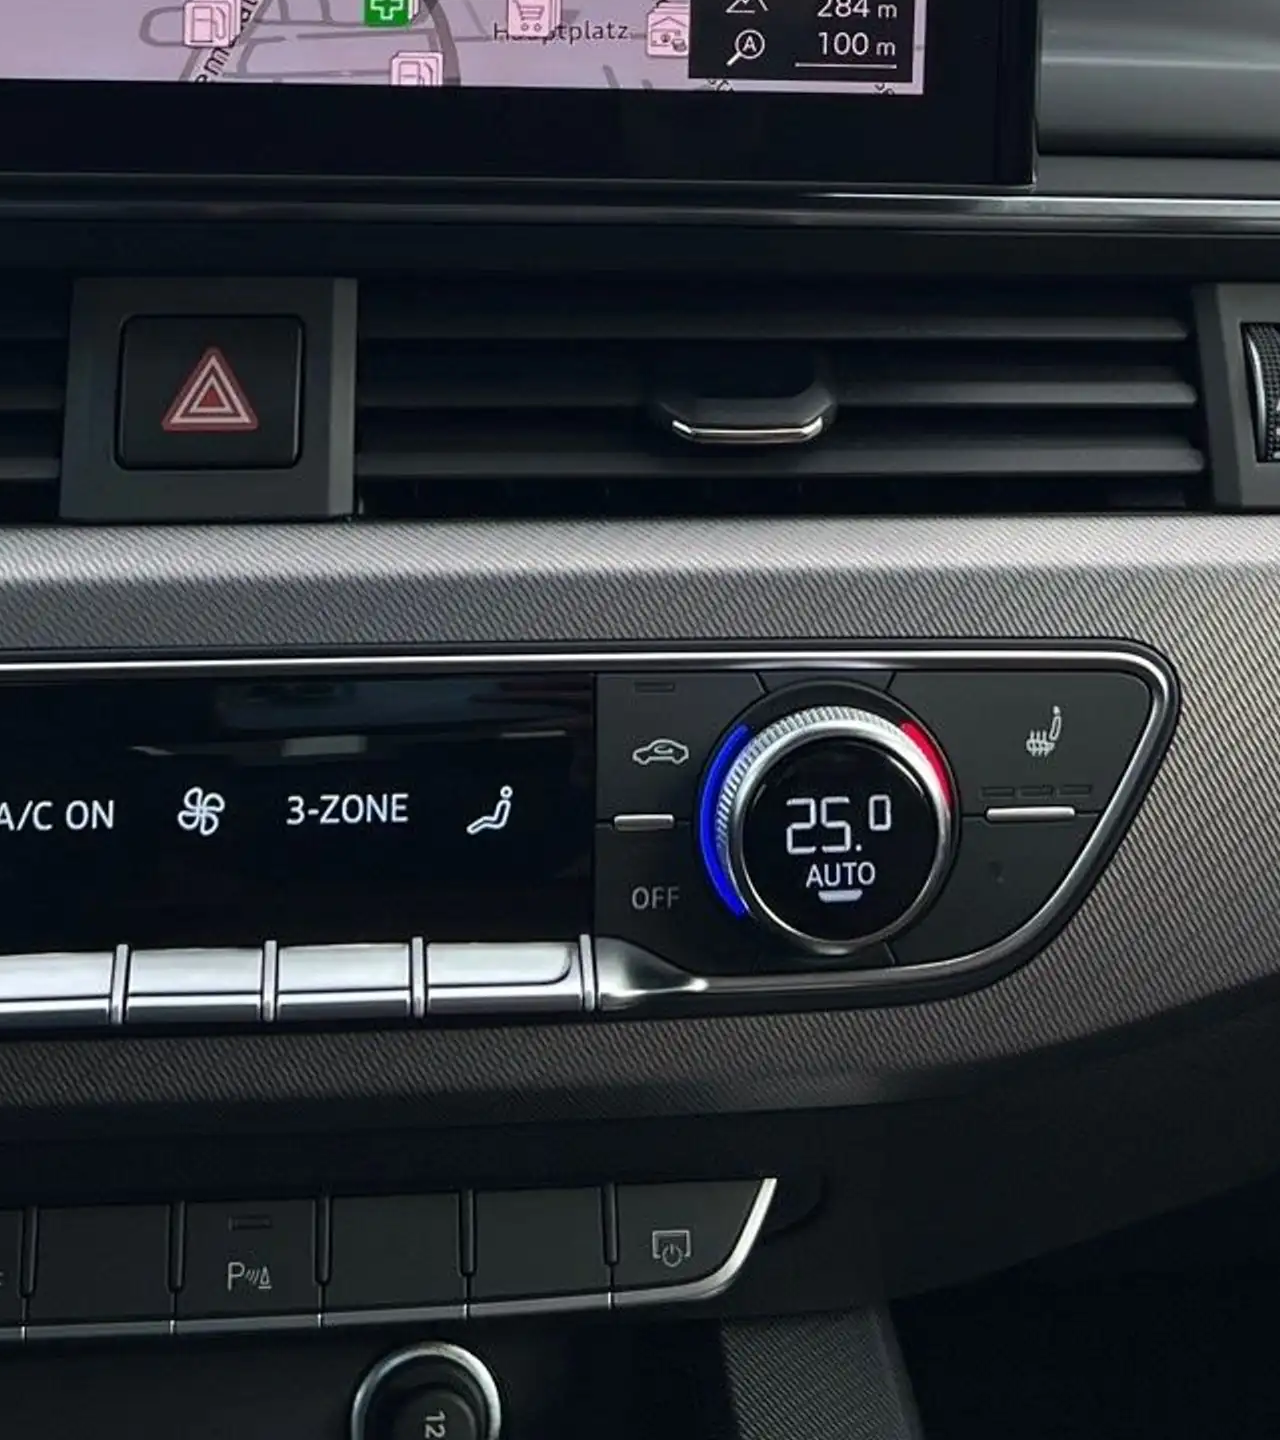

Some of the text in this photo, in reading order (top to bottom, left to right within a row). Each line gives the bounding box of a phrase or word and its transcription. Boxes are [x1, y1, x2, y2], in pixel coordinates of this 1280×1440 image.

[877, 4, 898, 18] m
[494, 22, 630, 45] Htplatz
[818, 31, 896, 56] 100 m
[65, 800, 115, 831] ON
[286, 793, 409, 825] 3-ZONE
[786, 794, 892, 855] 25.0
[806, 861, 876, 888] AUTO
[631, 886, 680, 910] OFF
[227, 1261, 246, 1291] P
